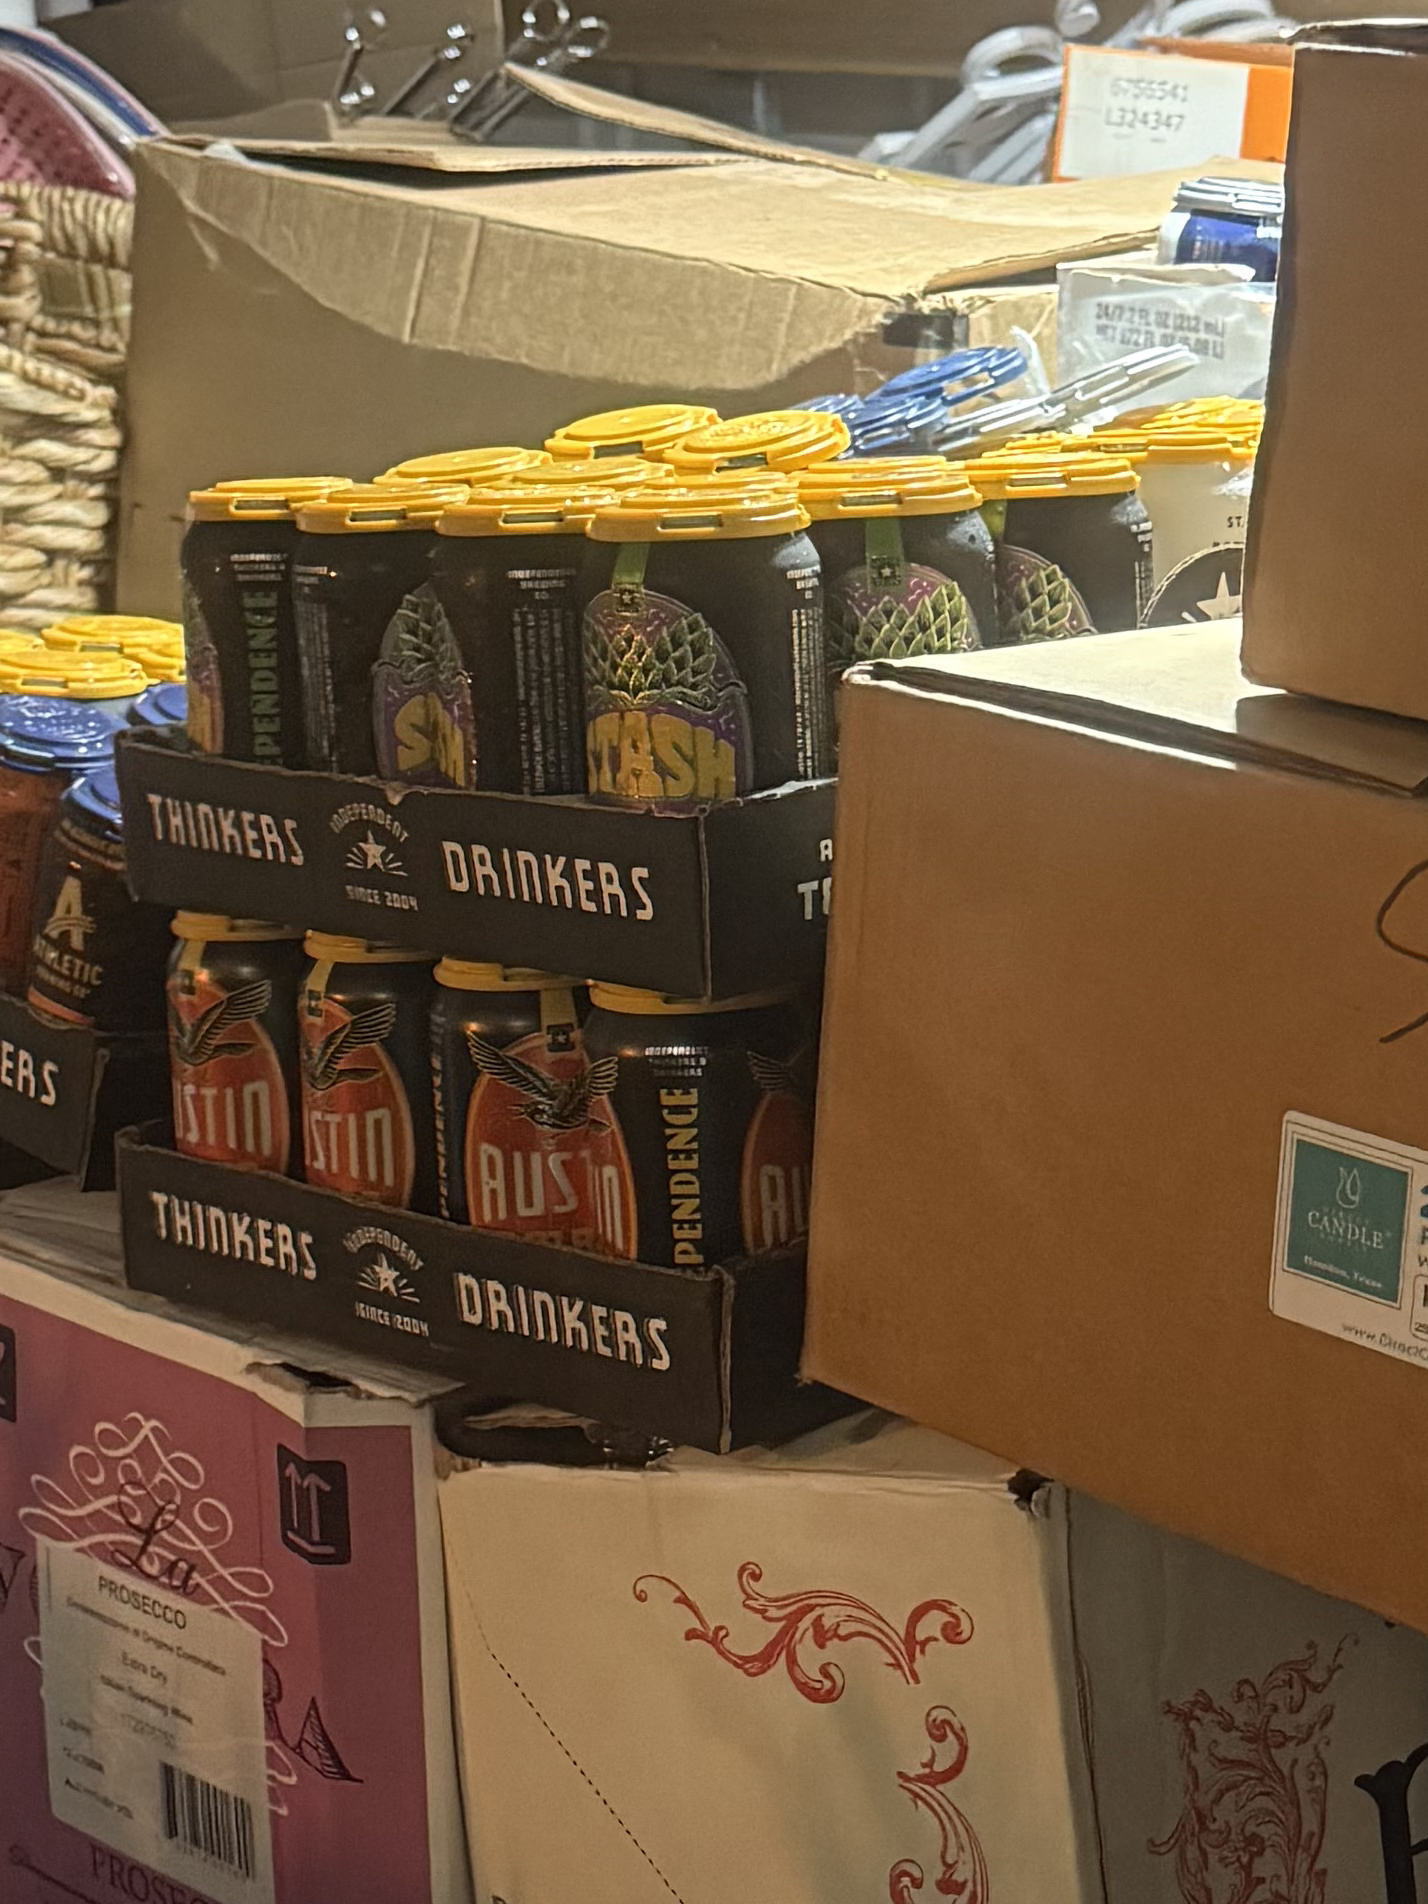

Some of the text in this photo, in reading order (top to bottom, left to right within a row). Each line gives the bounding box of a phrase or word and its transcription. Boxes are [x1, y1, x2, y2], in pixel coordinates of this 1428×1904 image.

[243, 592, 283, 757] PENDENCE
[147, 793, 304, 866] THINKERS
[329, 802, 410, 844] INDEPENDENT
[345, 884, 419, 912] SINCE 2004
[441, 840, 654, 921] DRINKERS
[306, 1107, 396, 1188] STIN
[659, 1087, 705, 1265] PENDENCE
[149, 1191, 317, 1281] THINKERS
[342, 1225, 425, 1272] INDEPENDENT
[1307, 1209, 1384, 1250] CANDLE
[454, 1272, 671, 1371] DRINKERS
[98, 1574, 188, 1631] PROSECCO
